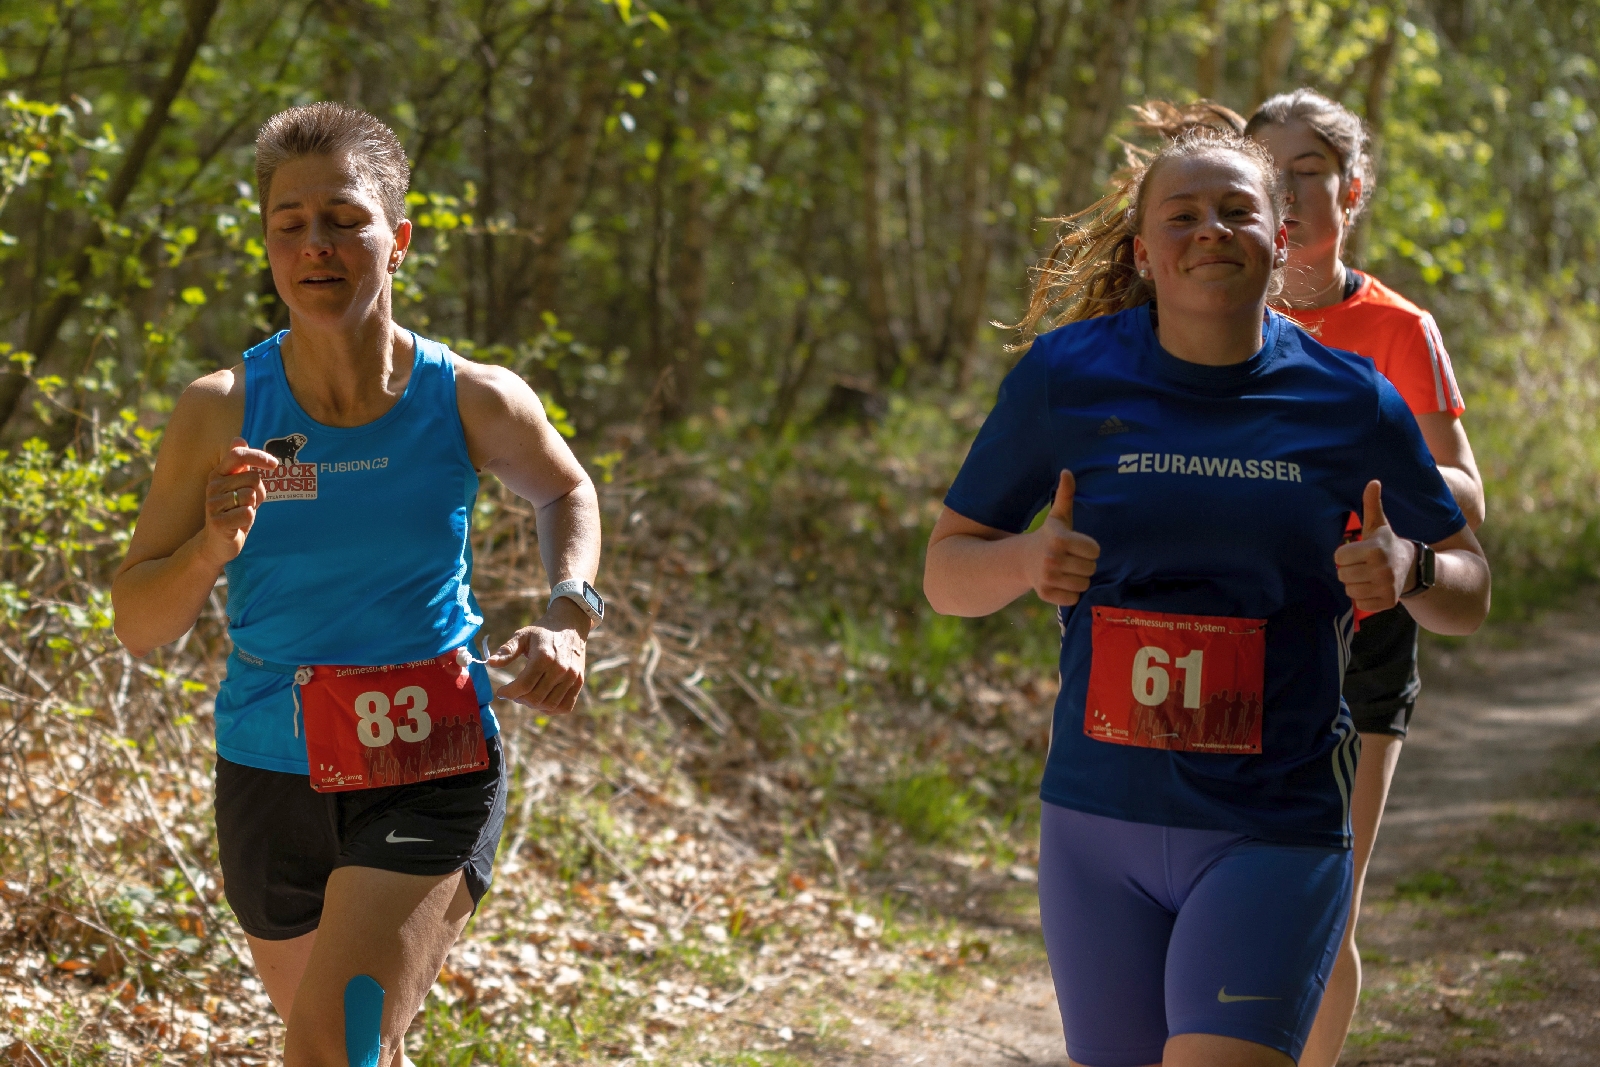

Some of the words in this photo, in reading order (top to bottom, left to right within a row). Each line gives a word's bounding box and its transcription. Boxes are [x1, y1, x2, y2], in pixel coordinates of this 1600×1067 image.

[320, 459, 370, 473] FUSION
[1140, 453, 1302, 483] EURAWASSER
[262, 478, 317, 493] OUSE
[1125, 616, 1174, 630] Zeitmessung
[1176, 620, 1191, 630] mit
[1194, 622, 1226, 634] System
[1131, 645, 1204, 709] 61
[354, 685, 432, 748] 83
